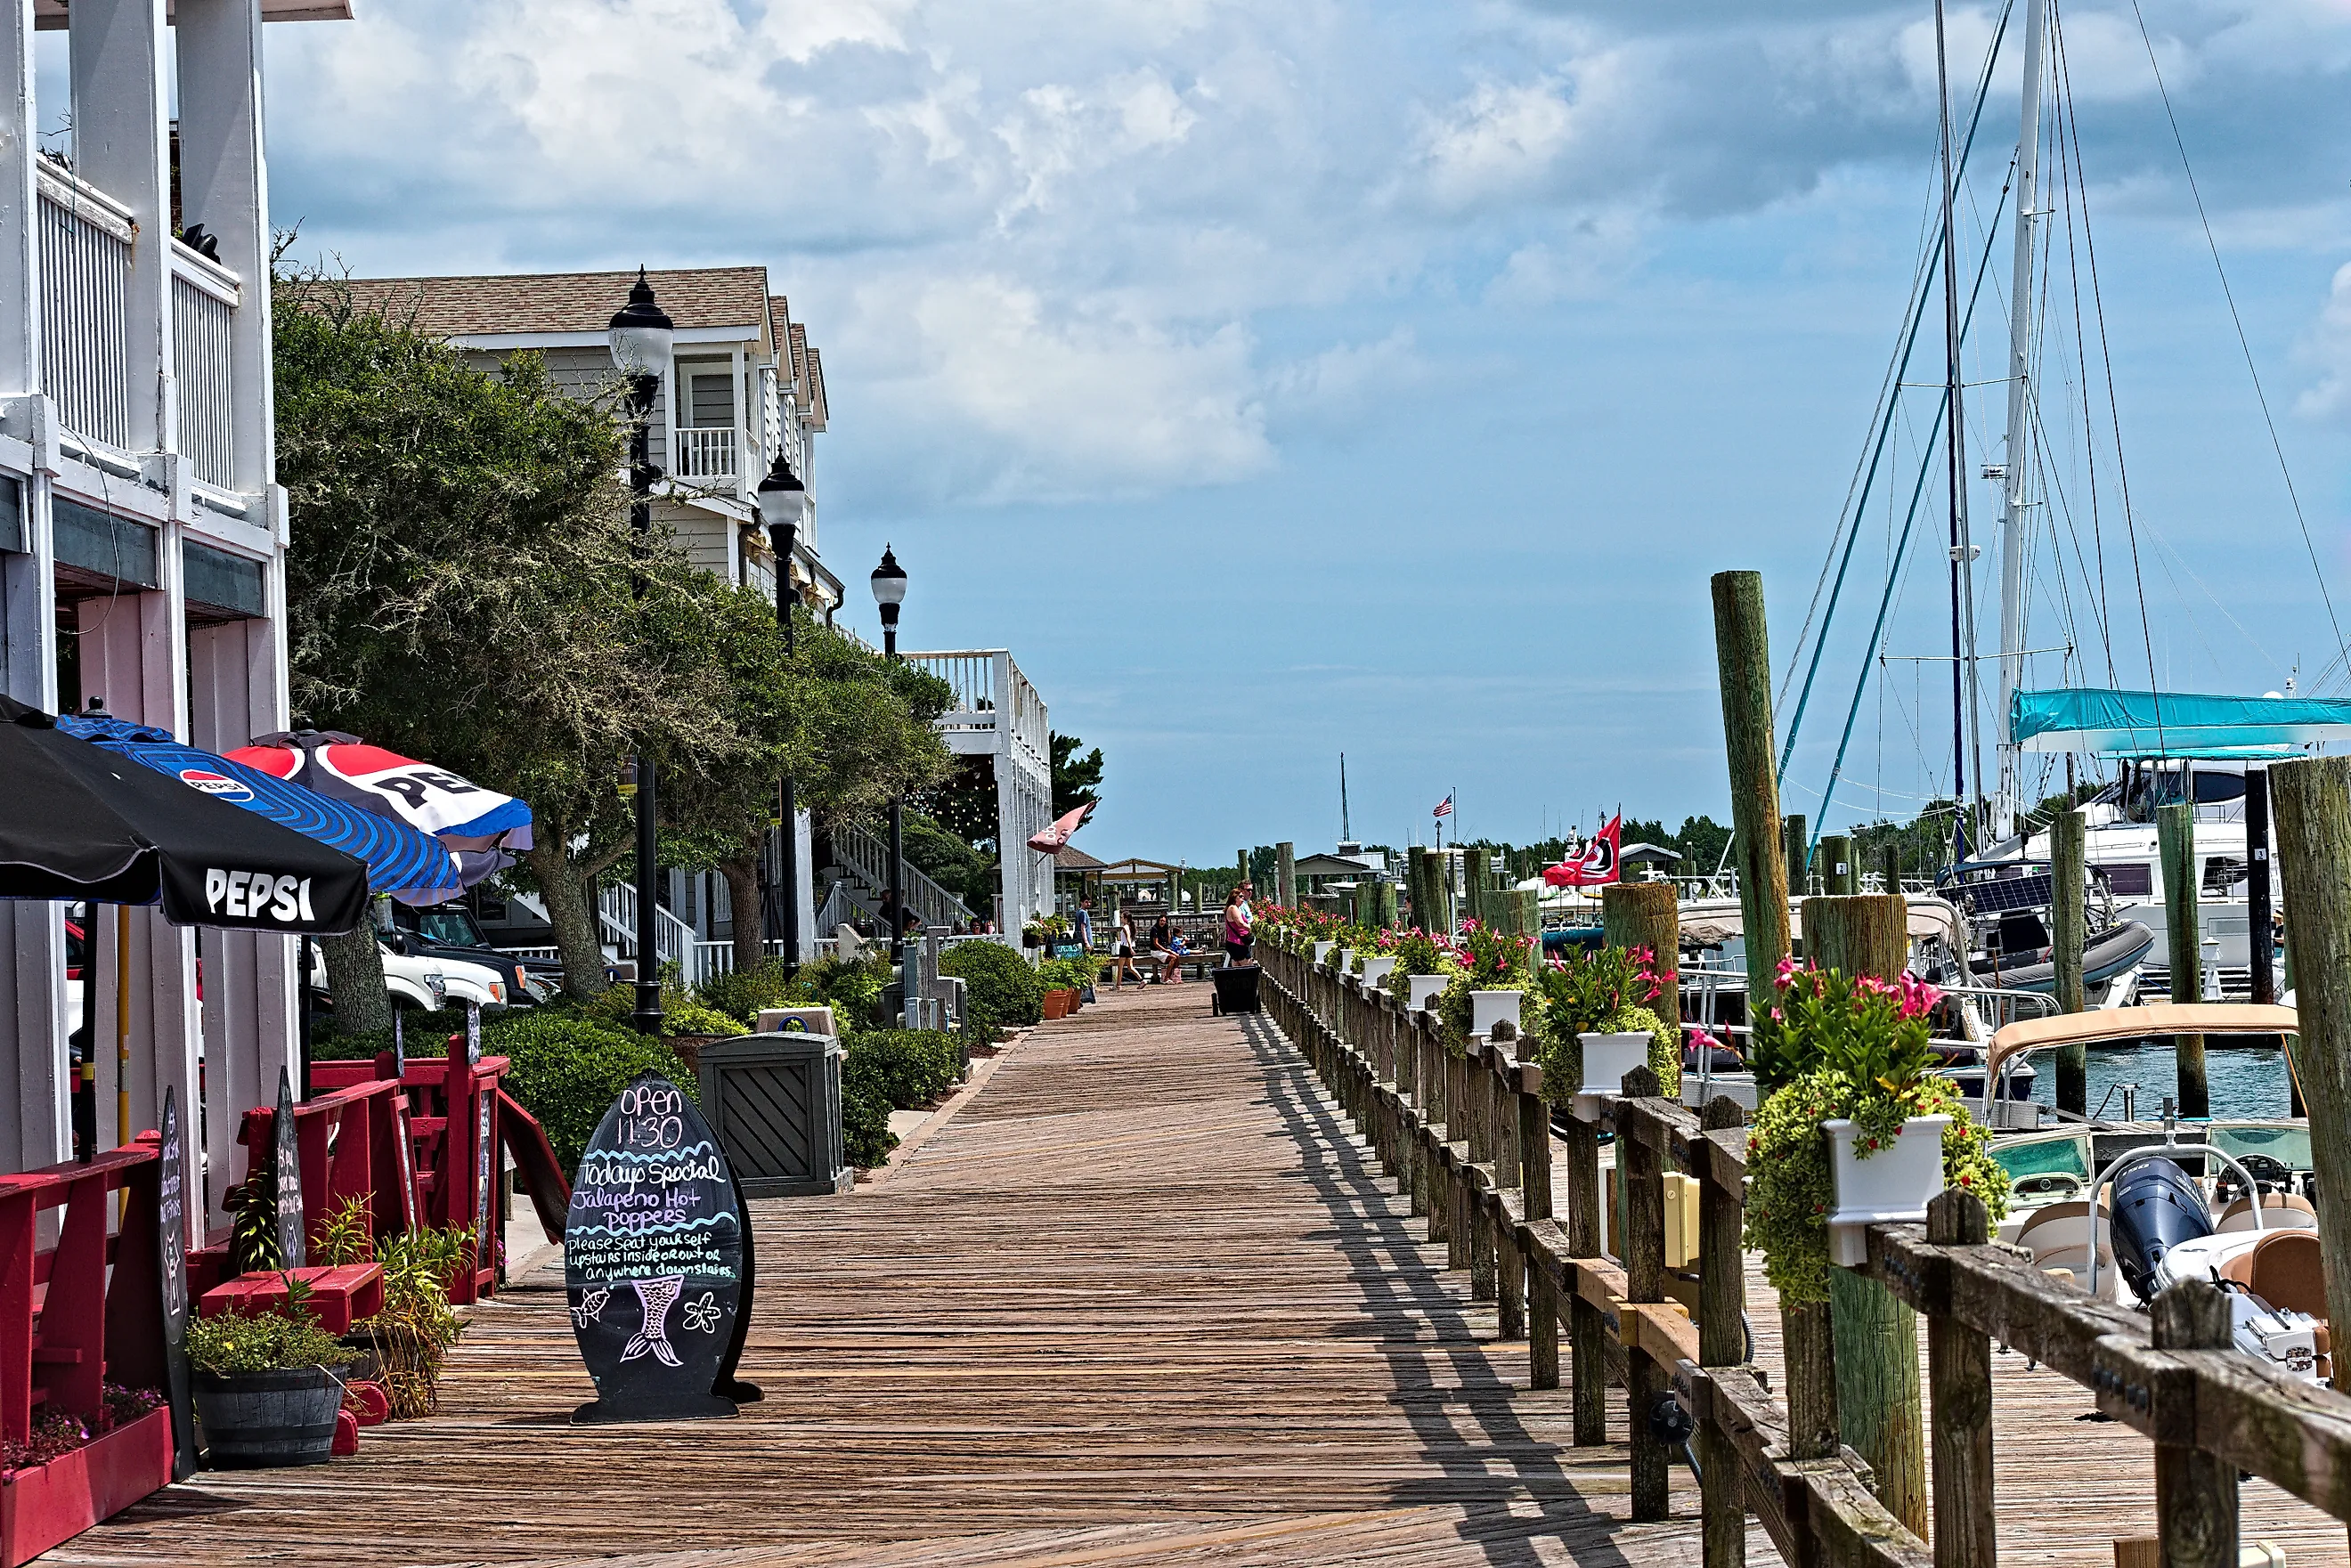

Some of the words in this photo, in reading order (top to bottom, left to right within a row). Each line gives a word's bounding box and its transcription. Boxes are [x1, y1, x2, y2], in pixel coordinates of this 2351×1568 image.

[190, 782, 244, 790] PEPSI
[206, 868, 315, 922] PEPSI
[648, 1156, 727, 1190] Special
[572, 1187, 660, 1212] Jalapeno
[665, 1187, 702, 1207] Hot
[585, 1264, 651, 1282] anywhere
